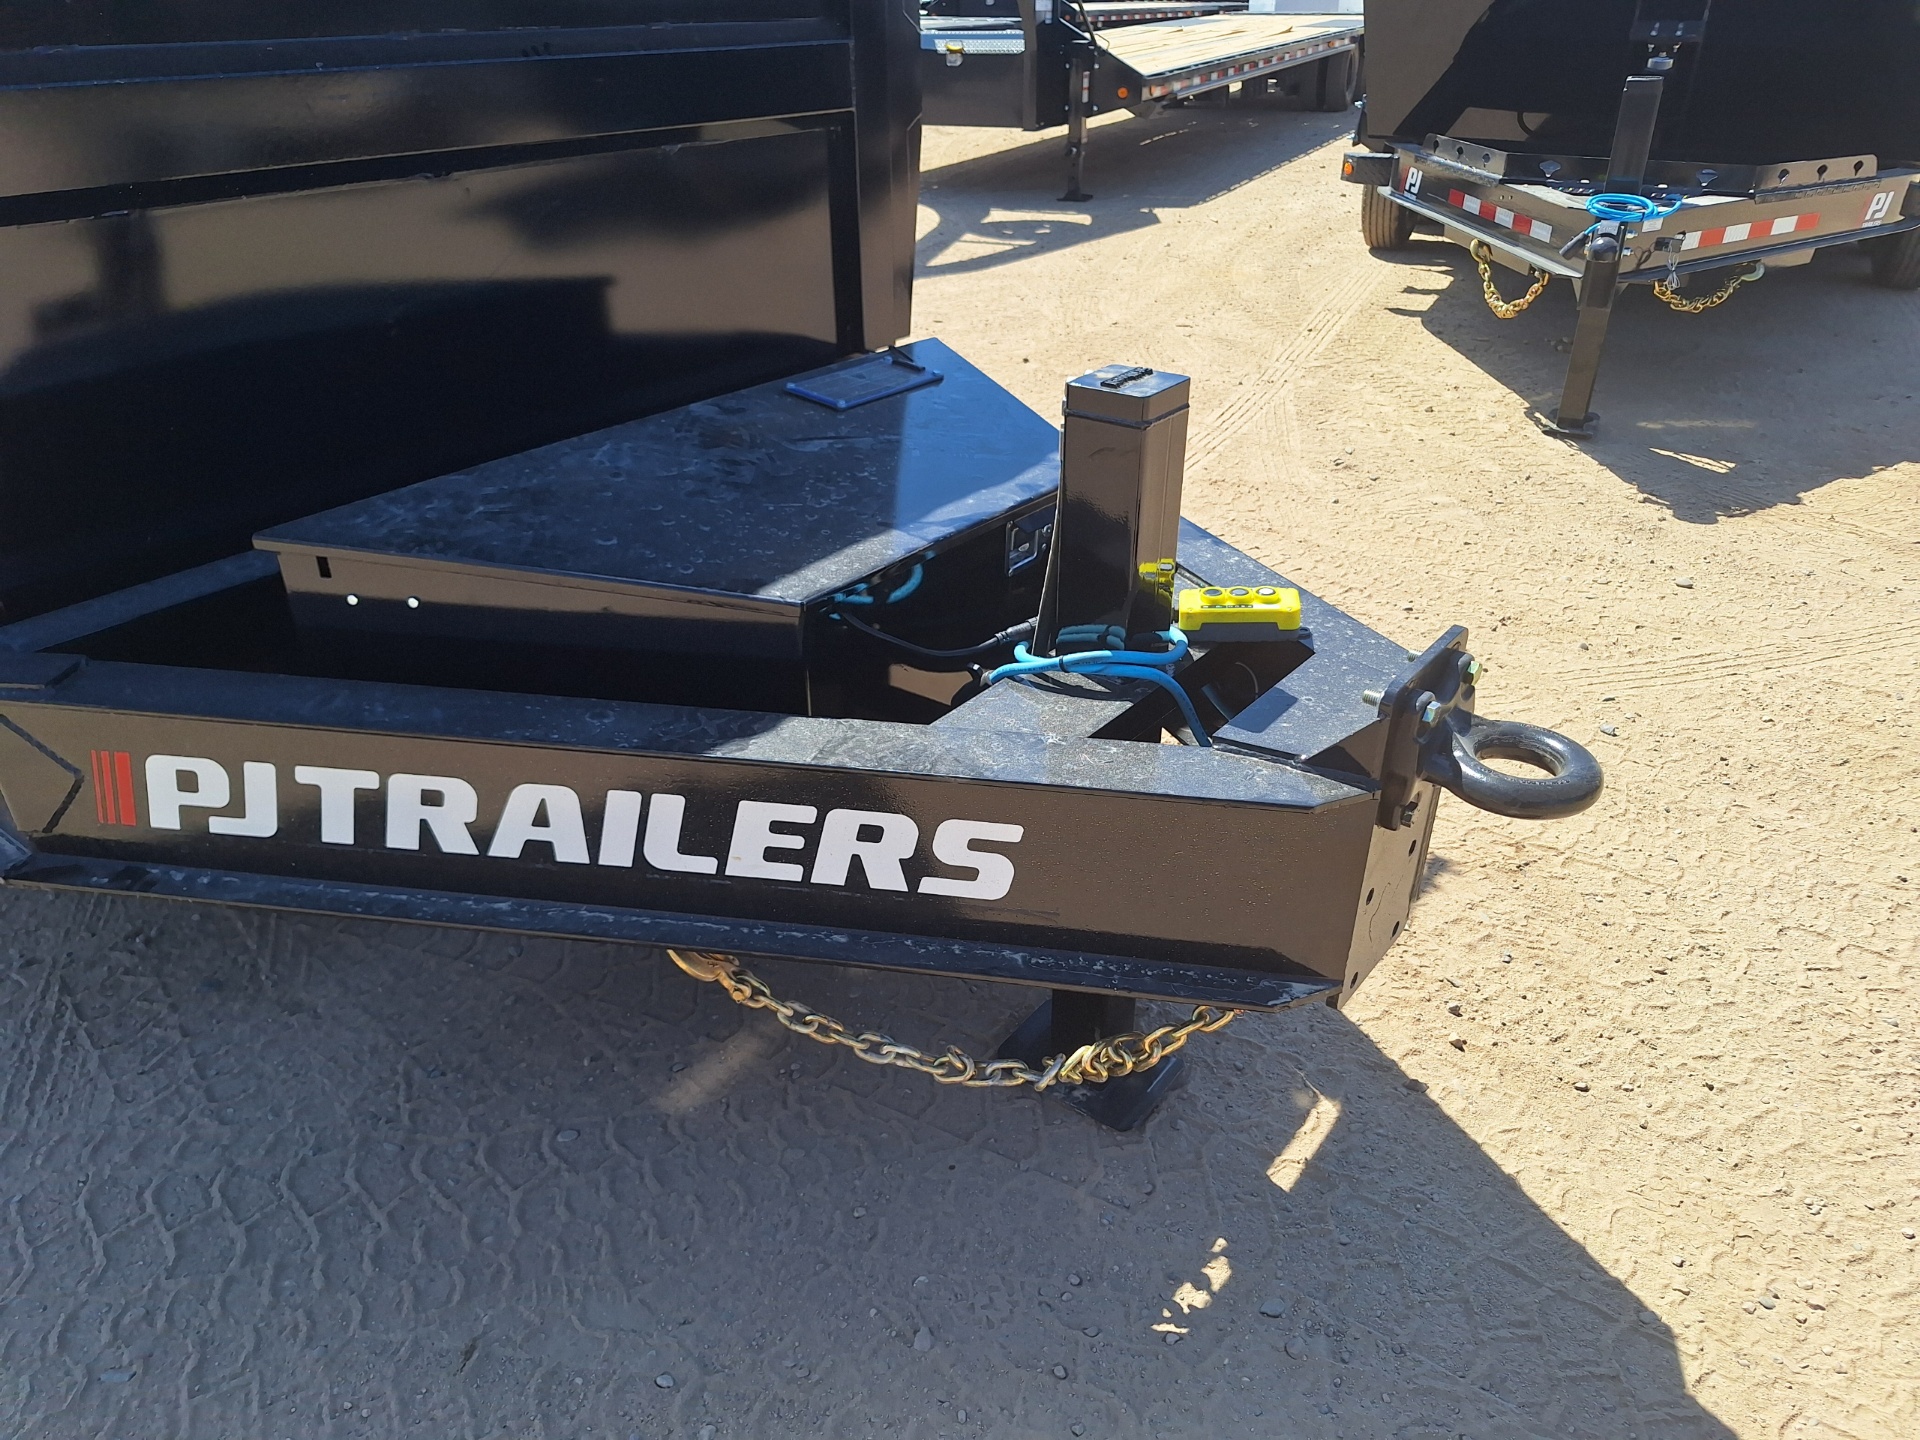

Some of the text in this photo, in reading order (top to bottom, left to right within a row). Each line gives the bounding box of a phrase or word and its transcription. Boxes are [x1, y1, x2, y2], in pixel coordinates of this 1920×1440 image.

[1404, 166, 1424, 194] PJ
[1864, 191, 1895, 220] PJ
[144, 754, 1025, 901] PJ TRAILERS
